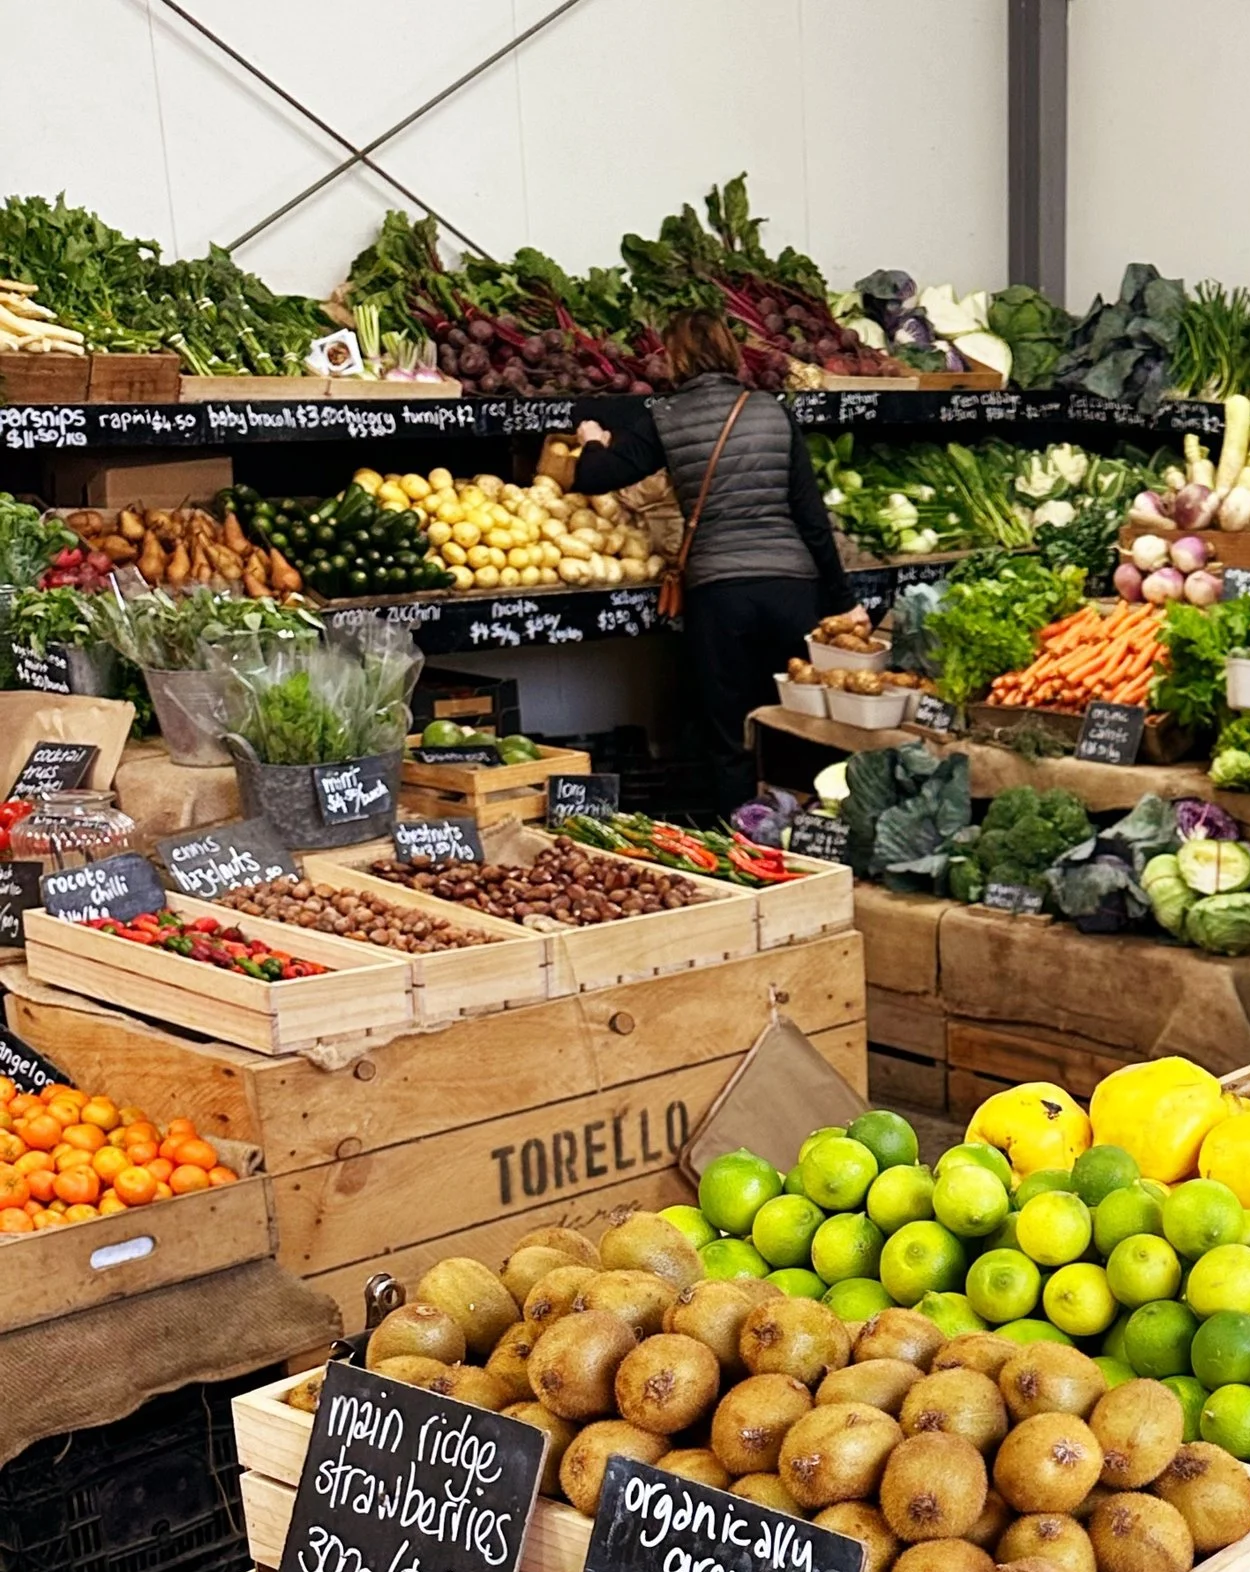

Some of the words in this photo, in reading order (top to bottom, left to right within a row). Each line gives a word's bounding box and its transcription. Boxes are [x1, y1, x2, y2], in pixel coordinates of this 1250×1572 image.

[0, 406, 86, 433] parsnips
[207, 404, 248, 435] baby
[401, 406, 456, 431] turnips
[33, 747, 87, 763] cocktail
[557, 778, 586, 803] long
[47, 868, 106, 895] rocoto
[170, 846, 261, 898] hazelnuts
[90, 875, 128, 905] chilli
[0, 1041, 55, 1086] angelo
[491, 1100, 689, 1205] TORELLO
[328, 1392, 401, 1453] main
[418, 1413, 501, 1498] ridge
[315, 1449, 511, 1565] strawberries
